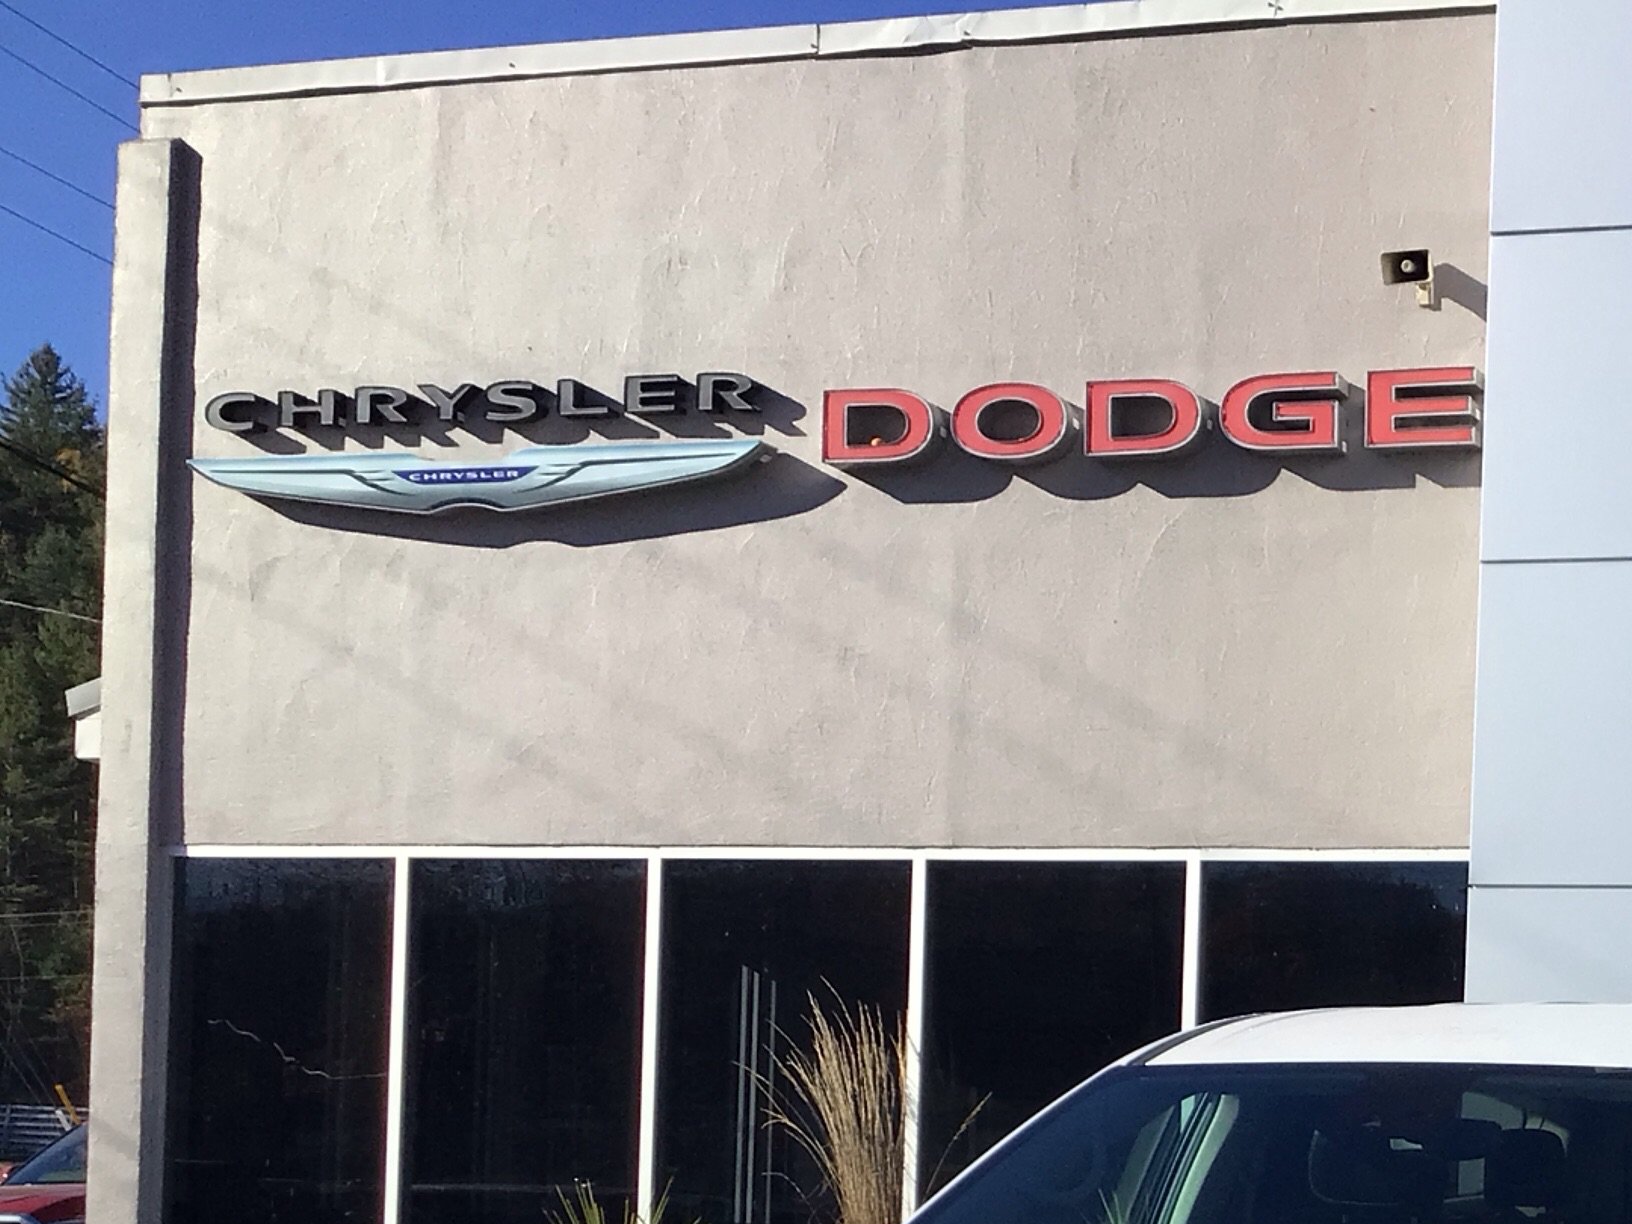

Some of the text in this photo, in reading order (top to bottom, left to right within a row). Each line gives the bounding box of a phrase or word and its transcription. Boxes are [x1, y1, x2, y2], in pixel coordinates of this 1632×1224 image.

[205, 371, 760, 432] CHRYSLER
[823, 366, 1479, 463] DODGE
[408, 470, 519, 481] CHRYSLER
